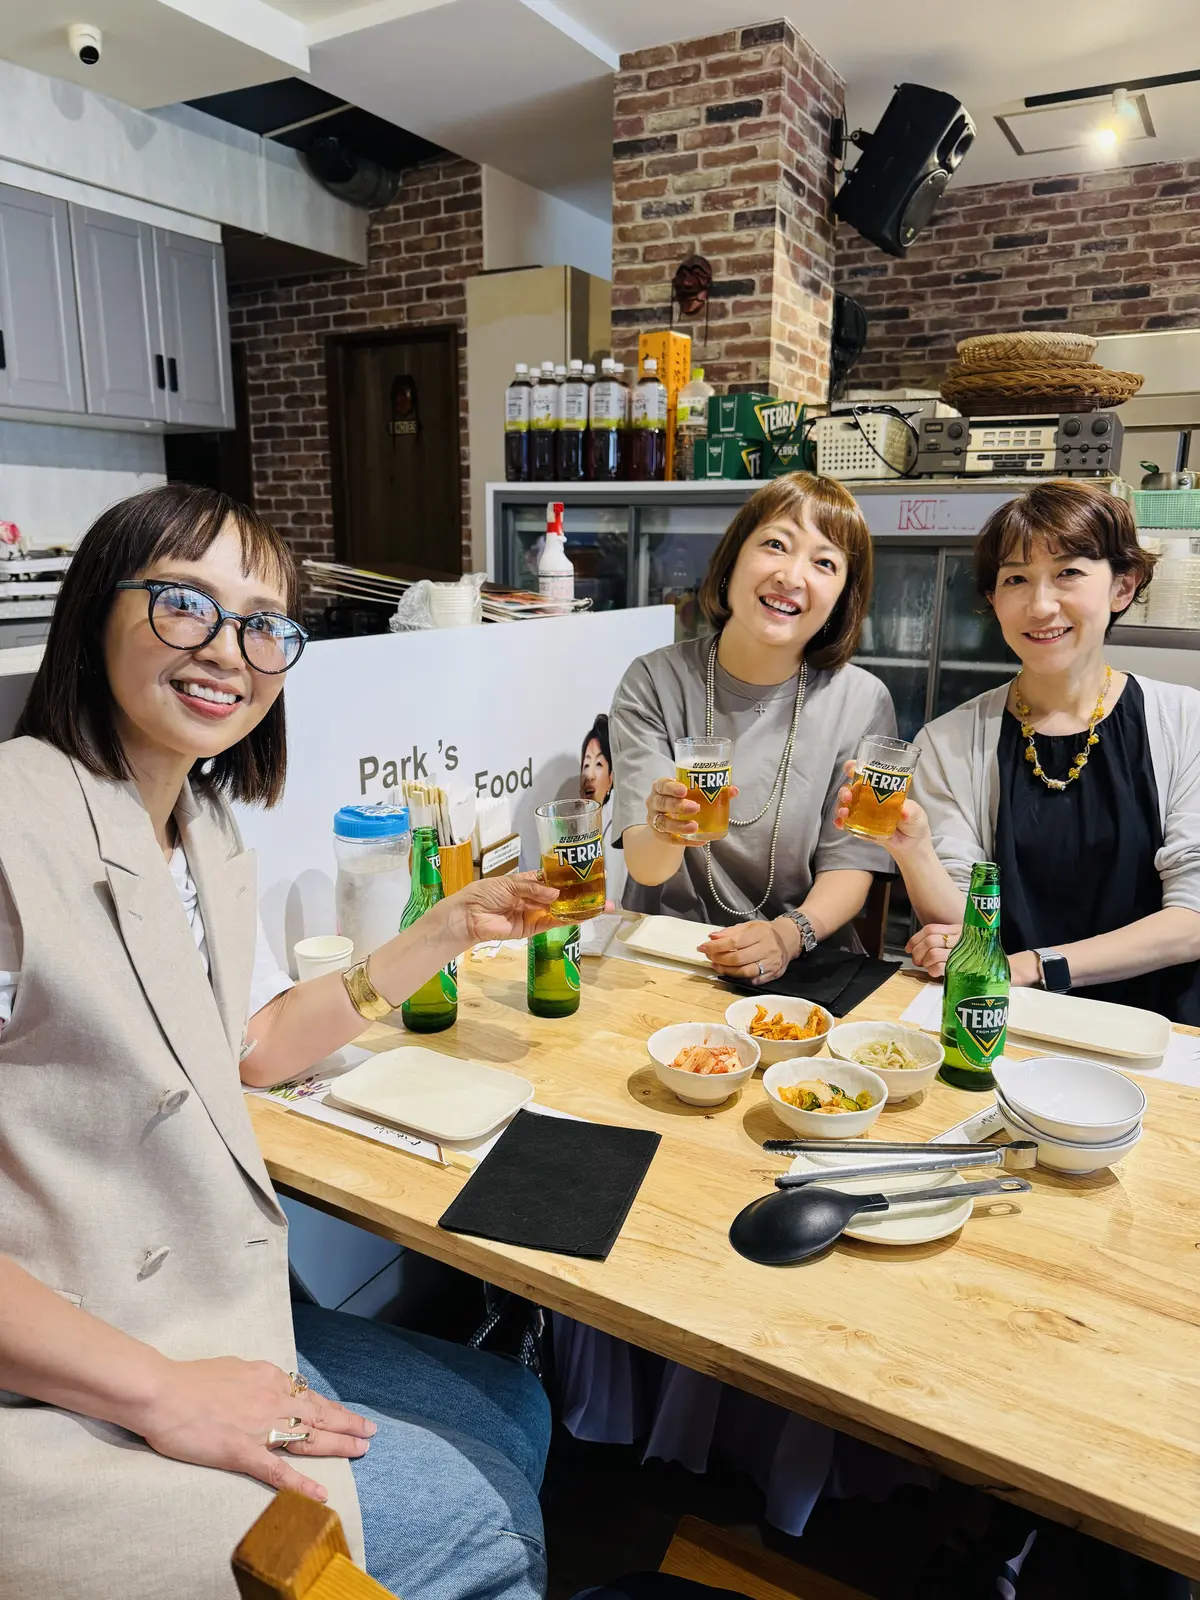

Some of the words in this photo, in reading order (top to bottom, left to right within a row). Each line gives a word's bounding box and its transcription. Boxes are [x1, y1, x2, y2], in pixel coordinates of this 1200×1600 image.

[762, 403, 797, 435] TERRA
[359, 745, 428, 796] Park
[475, 757, 533, 799] Food
[687, 770, 730, 789] TERRA
[862, 768, 908, 792] TERRA
[554, 840, 602, 866] TERRA
[957, 1005, 1008, 1029] TERRA
